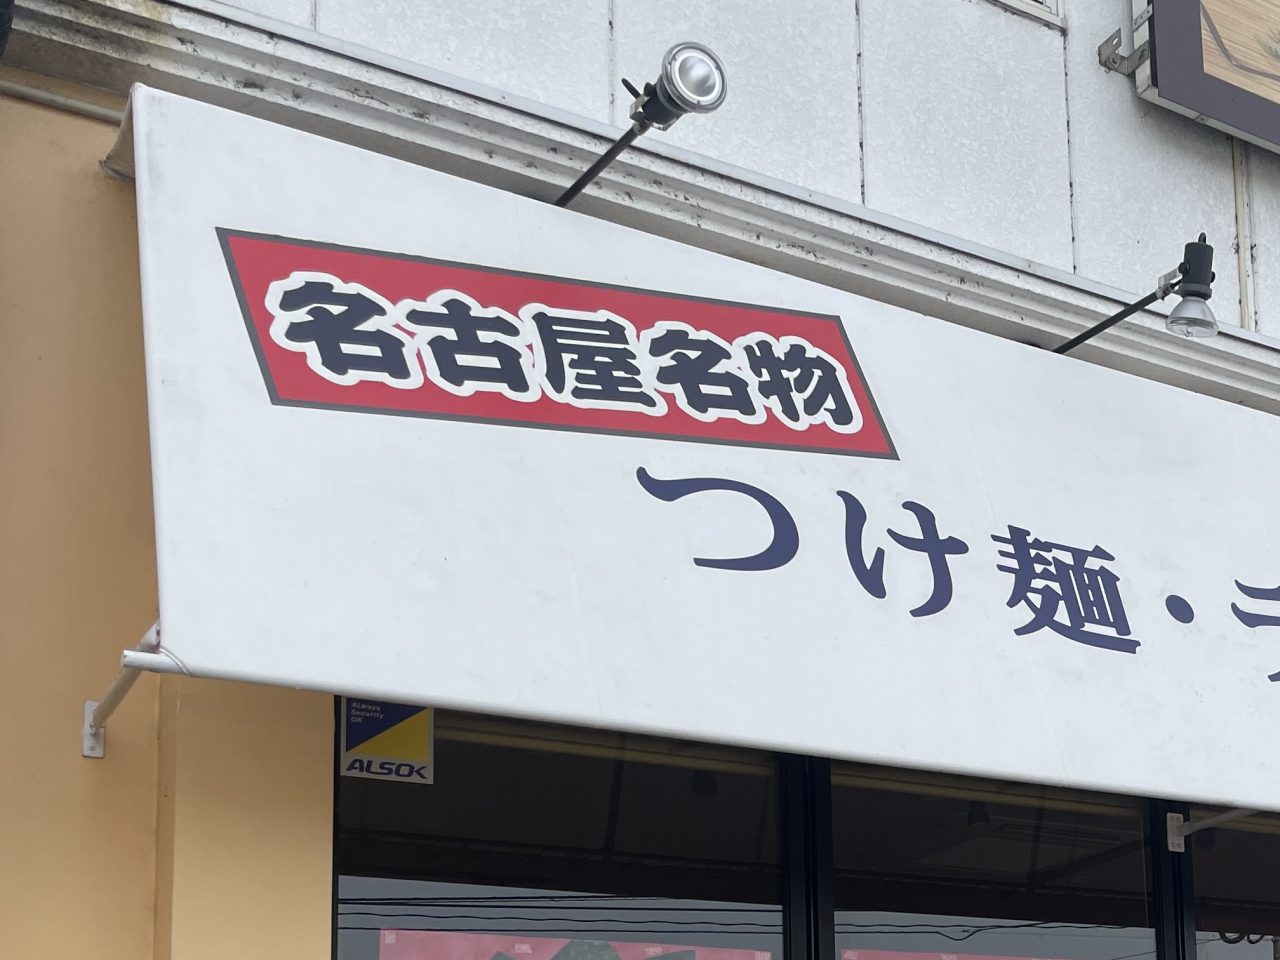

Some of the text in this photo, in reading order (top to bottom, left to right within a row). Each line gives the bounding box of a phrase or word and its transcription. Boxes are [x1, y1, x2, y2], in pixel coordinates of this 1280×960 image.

[272, 276, 859, 432] 名古屋名物
[346, 759, 428, 780] ALSOK
